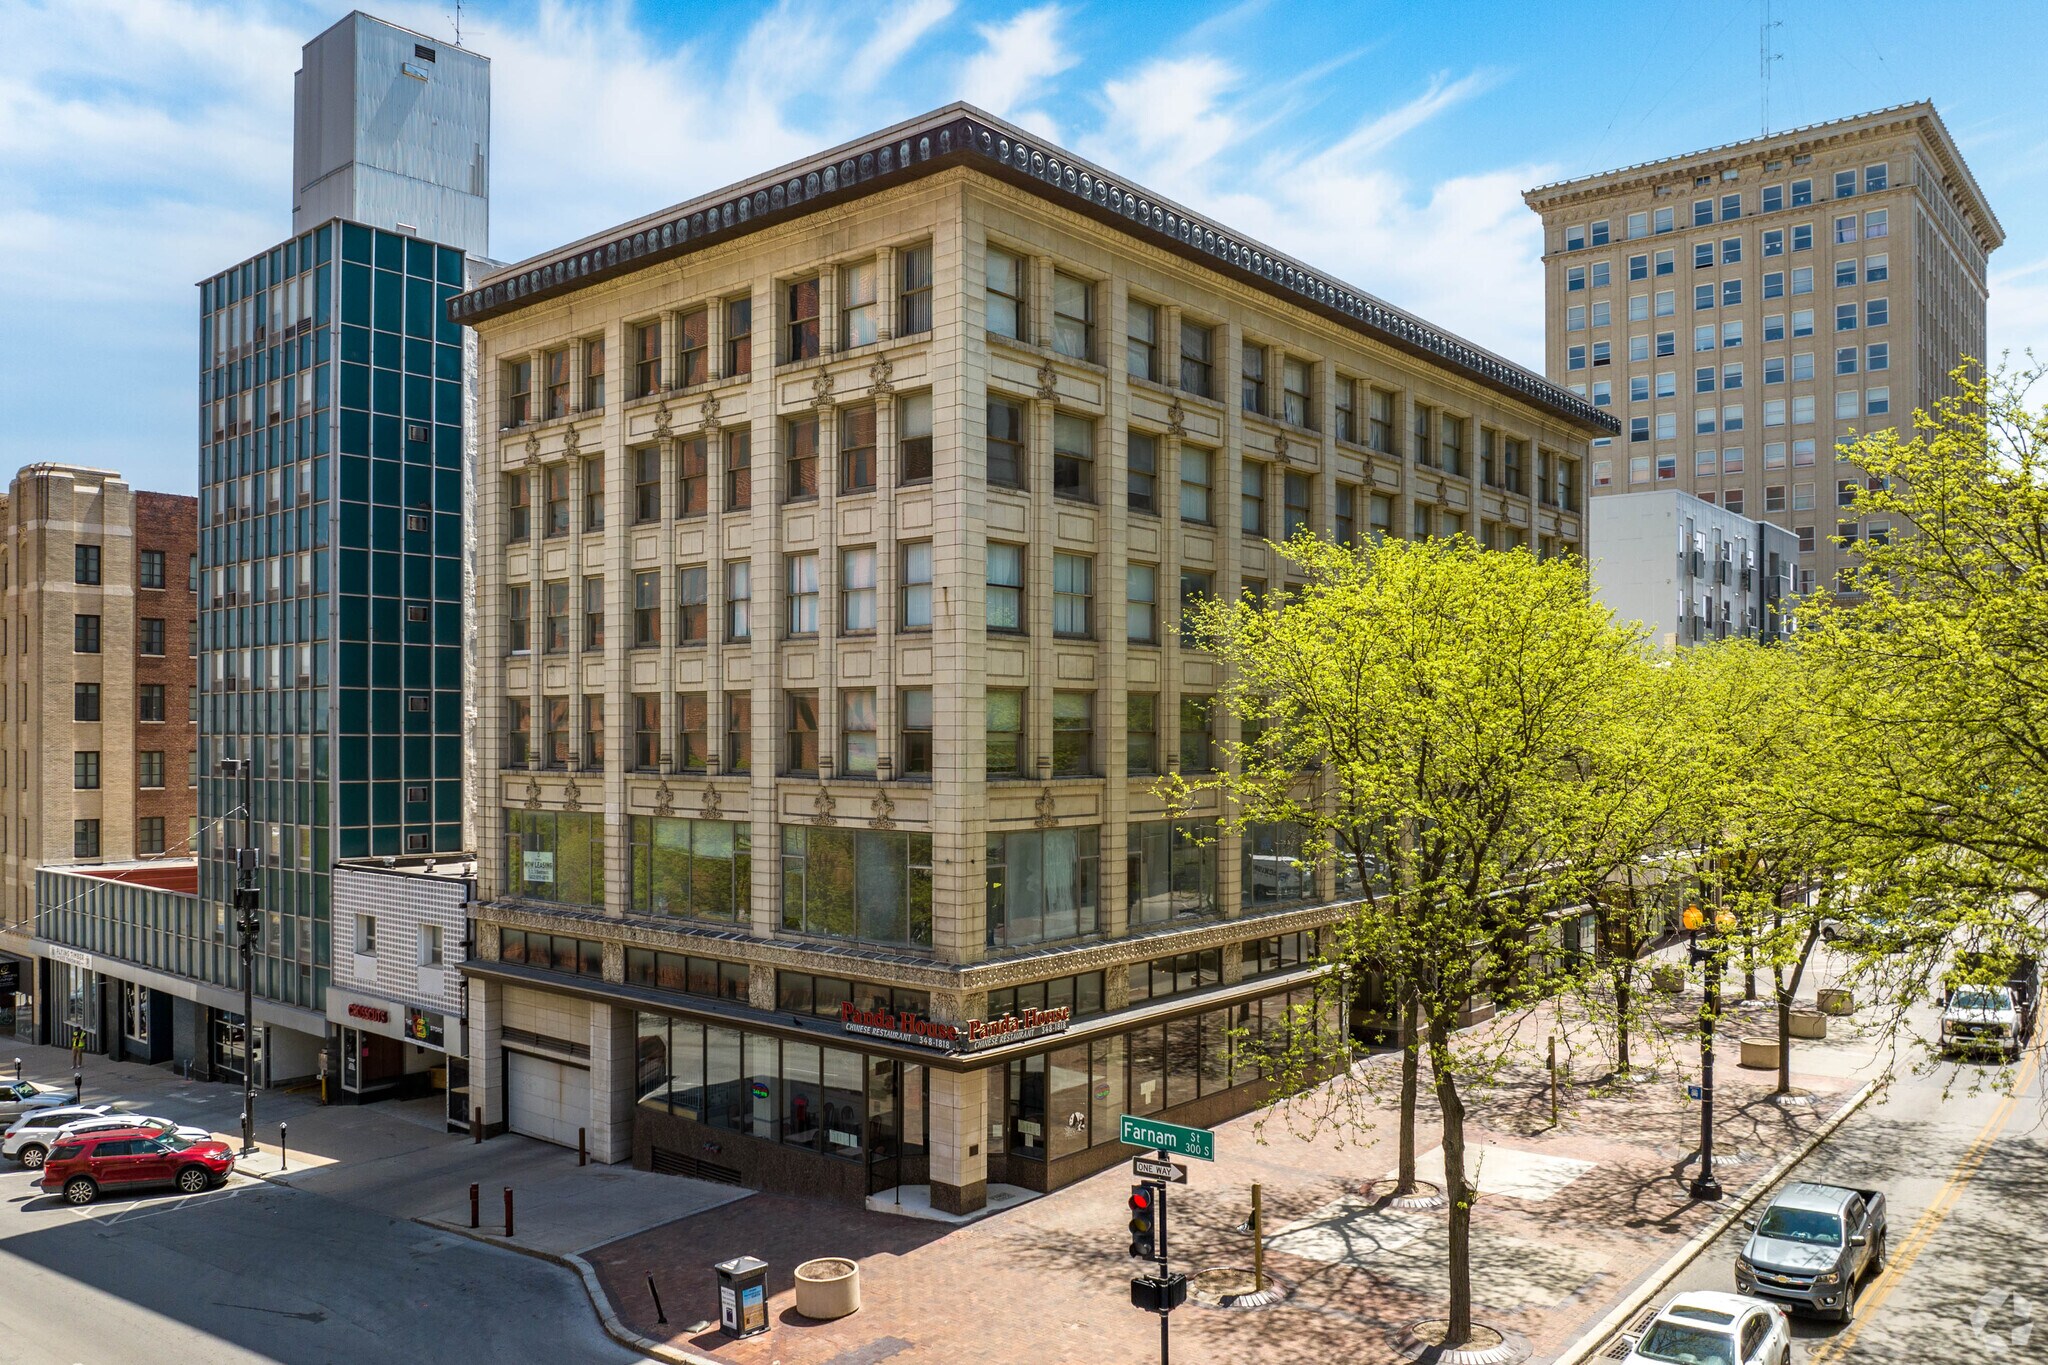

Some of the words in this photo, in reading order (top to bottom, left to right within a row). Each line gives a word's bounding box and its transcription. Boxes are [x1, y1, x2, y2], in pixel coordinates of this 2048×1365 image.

[348, 1003, 389, 1024] CROSSCUTS
[841, 1000, 896, 1030] Panda
[900, 1011, 960, 1041] House
[967, 1012, 1019, 1043] Panda
[1023, 1005, 1070, 1030] House
[845, 1022, 871, 1035] CHINESE
[871, 1026, 912, 1042] RESTAURANT
[919, 1035, 950, 1050] 348-1818
[974, 1036, 999, 1050] CHINESE
[999, 1028, 1035, 1044] RESTAURANT
[1041, 1021, 1067, 1035] 348-1818
[1124, 1121, 1177, 1147] Farnam
[1190, 1132, 1200, 1143] St
[1185, 1143, 1201, 1155] 300
[1204, 1146, 1209, 1156] S
[1138, 1162, 1154, 1173] ONE
[1156, 1166, 1172, 1176] WAY
